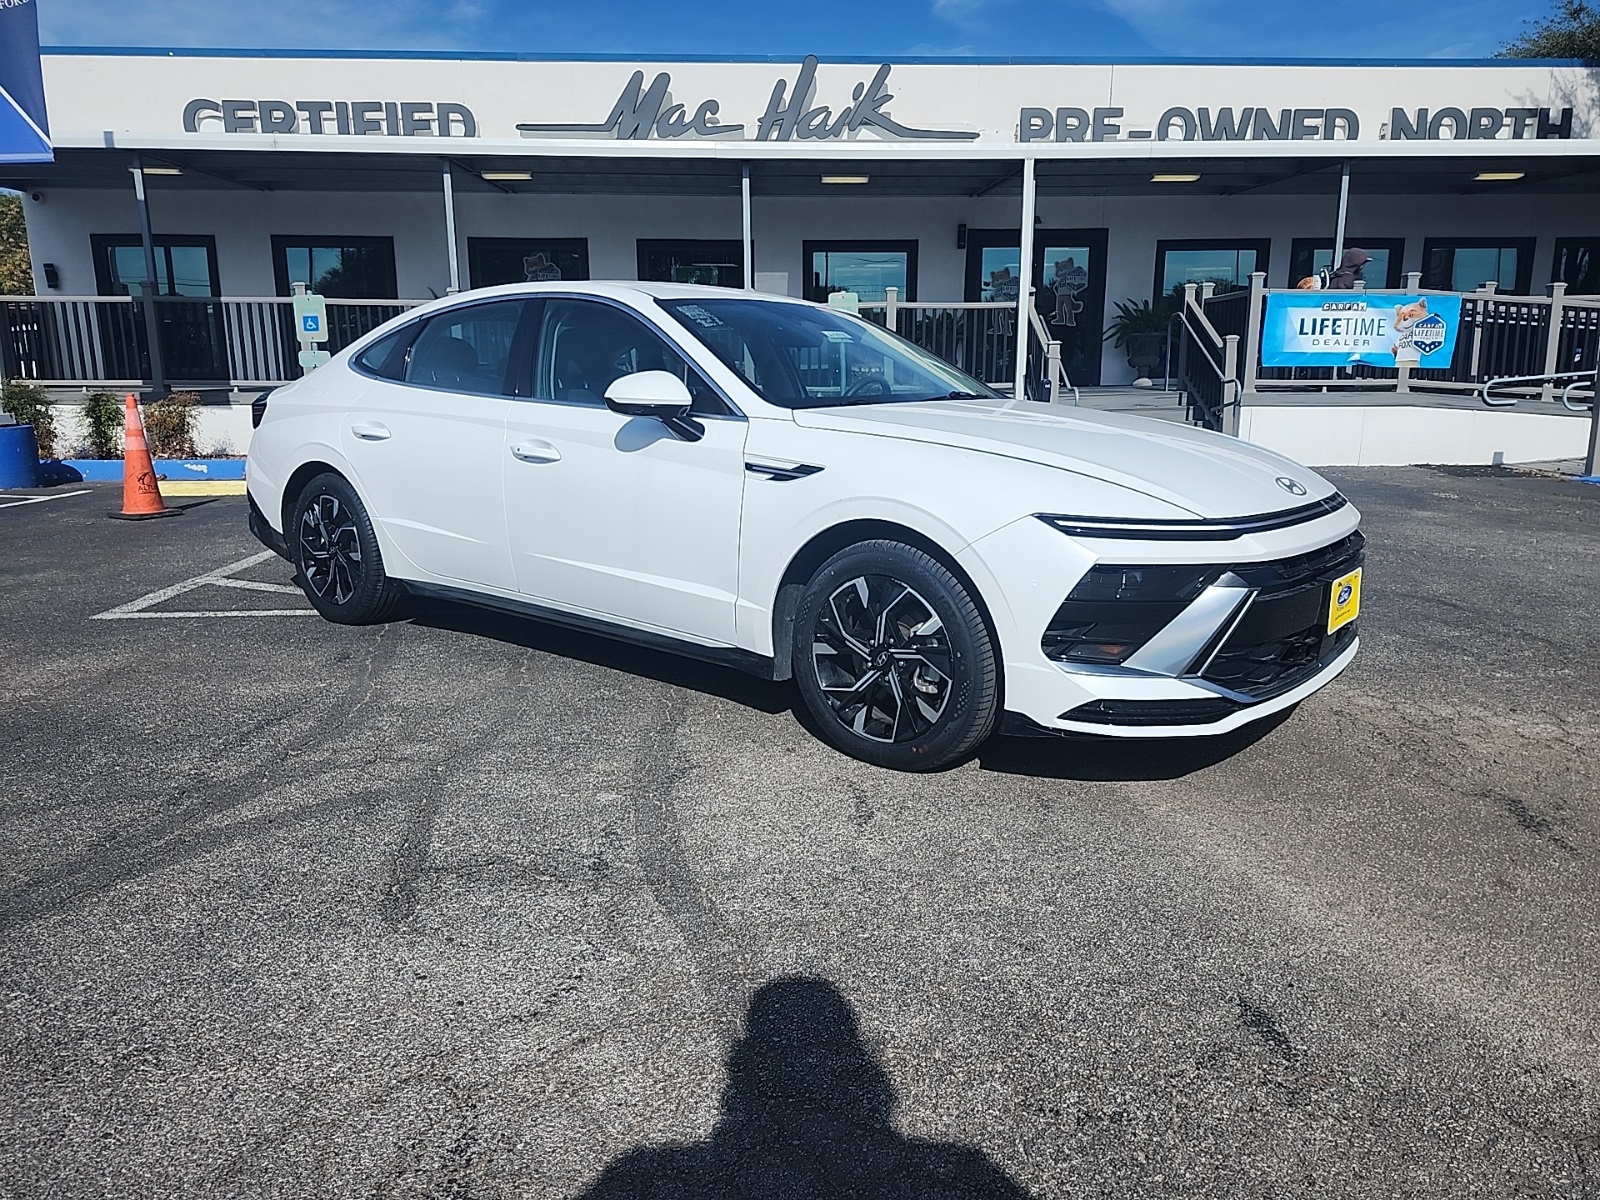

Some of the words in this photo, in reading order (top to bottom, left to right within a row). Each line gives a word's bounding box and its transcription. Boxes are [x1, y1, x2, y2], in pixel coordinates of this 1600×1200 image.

[516, 70, 744, 140] Mac
[755, 54, 980, 141] Haik
[183, 98, 476, 137] CERTIFIED
[1020, 107, 1360, 142] PRE-OWNED
[1389, 107, 1573, 140] NORTH
[1322, 302, 1367, 311] CARFAX
[1299, 317, 1387, 336] LIFETIME
[1414, 329, 1444, 337] LIFETIME
